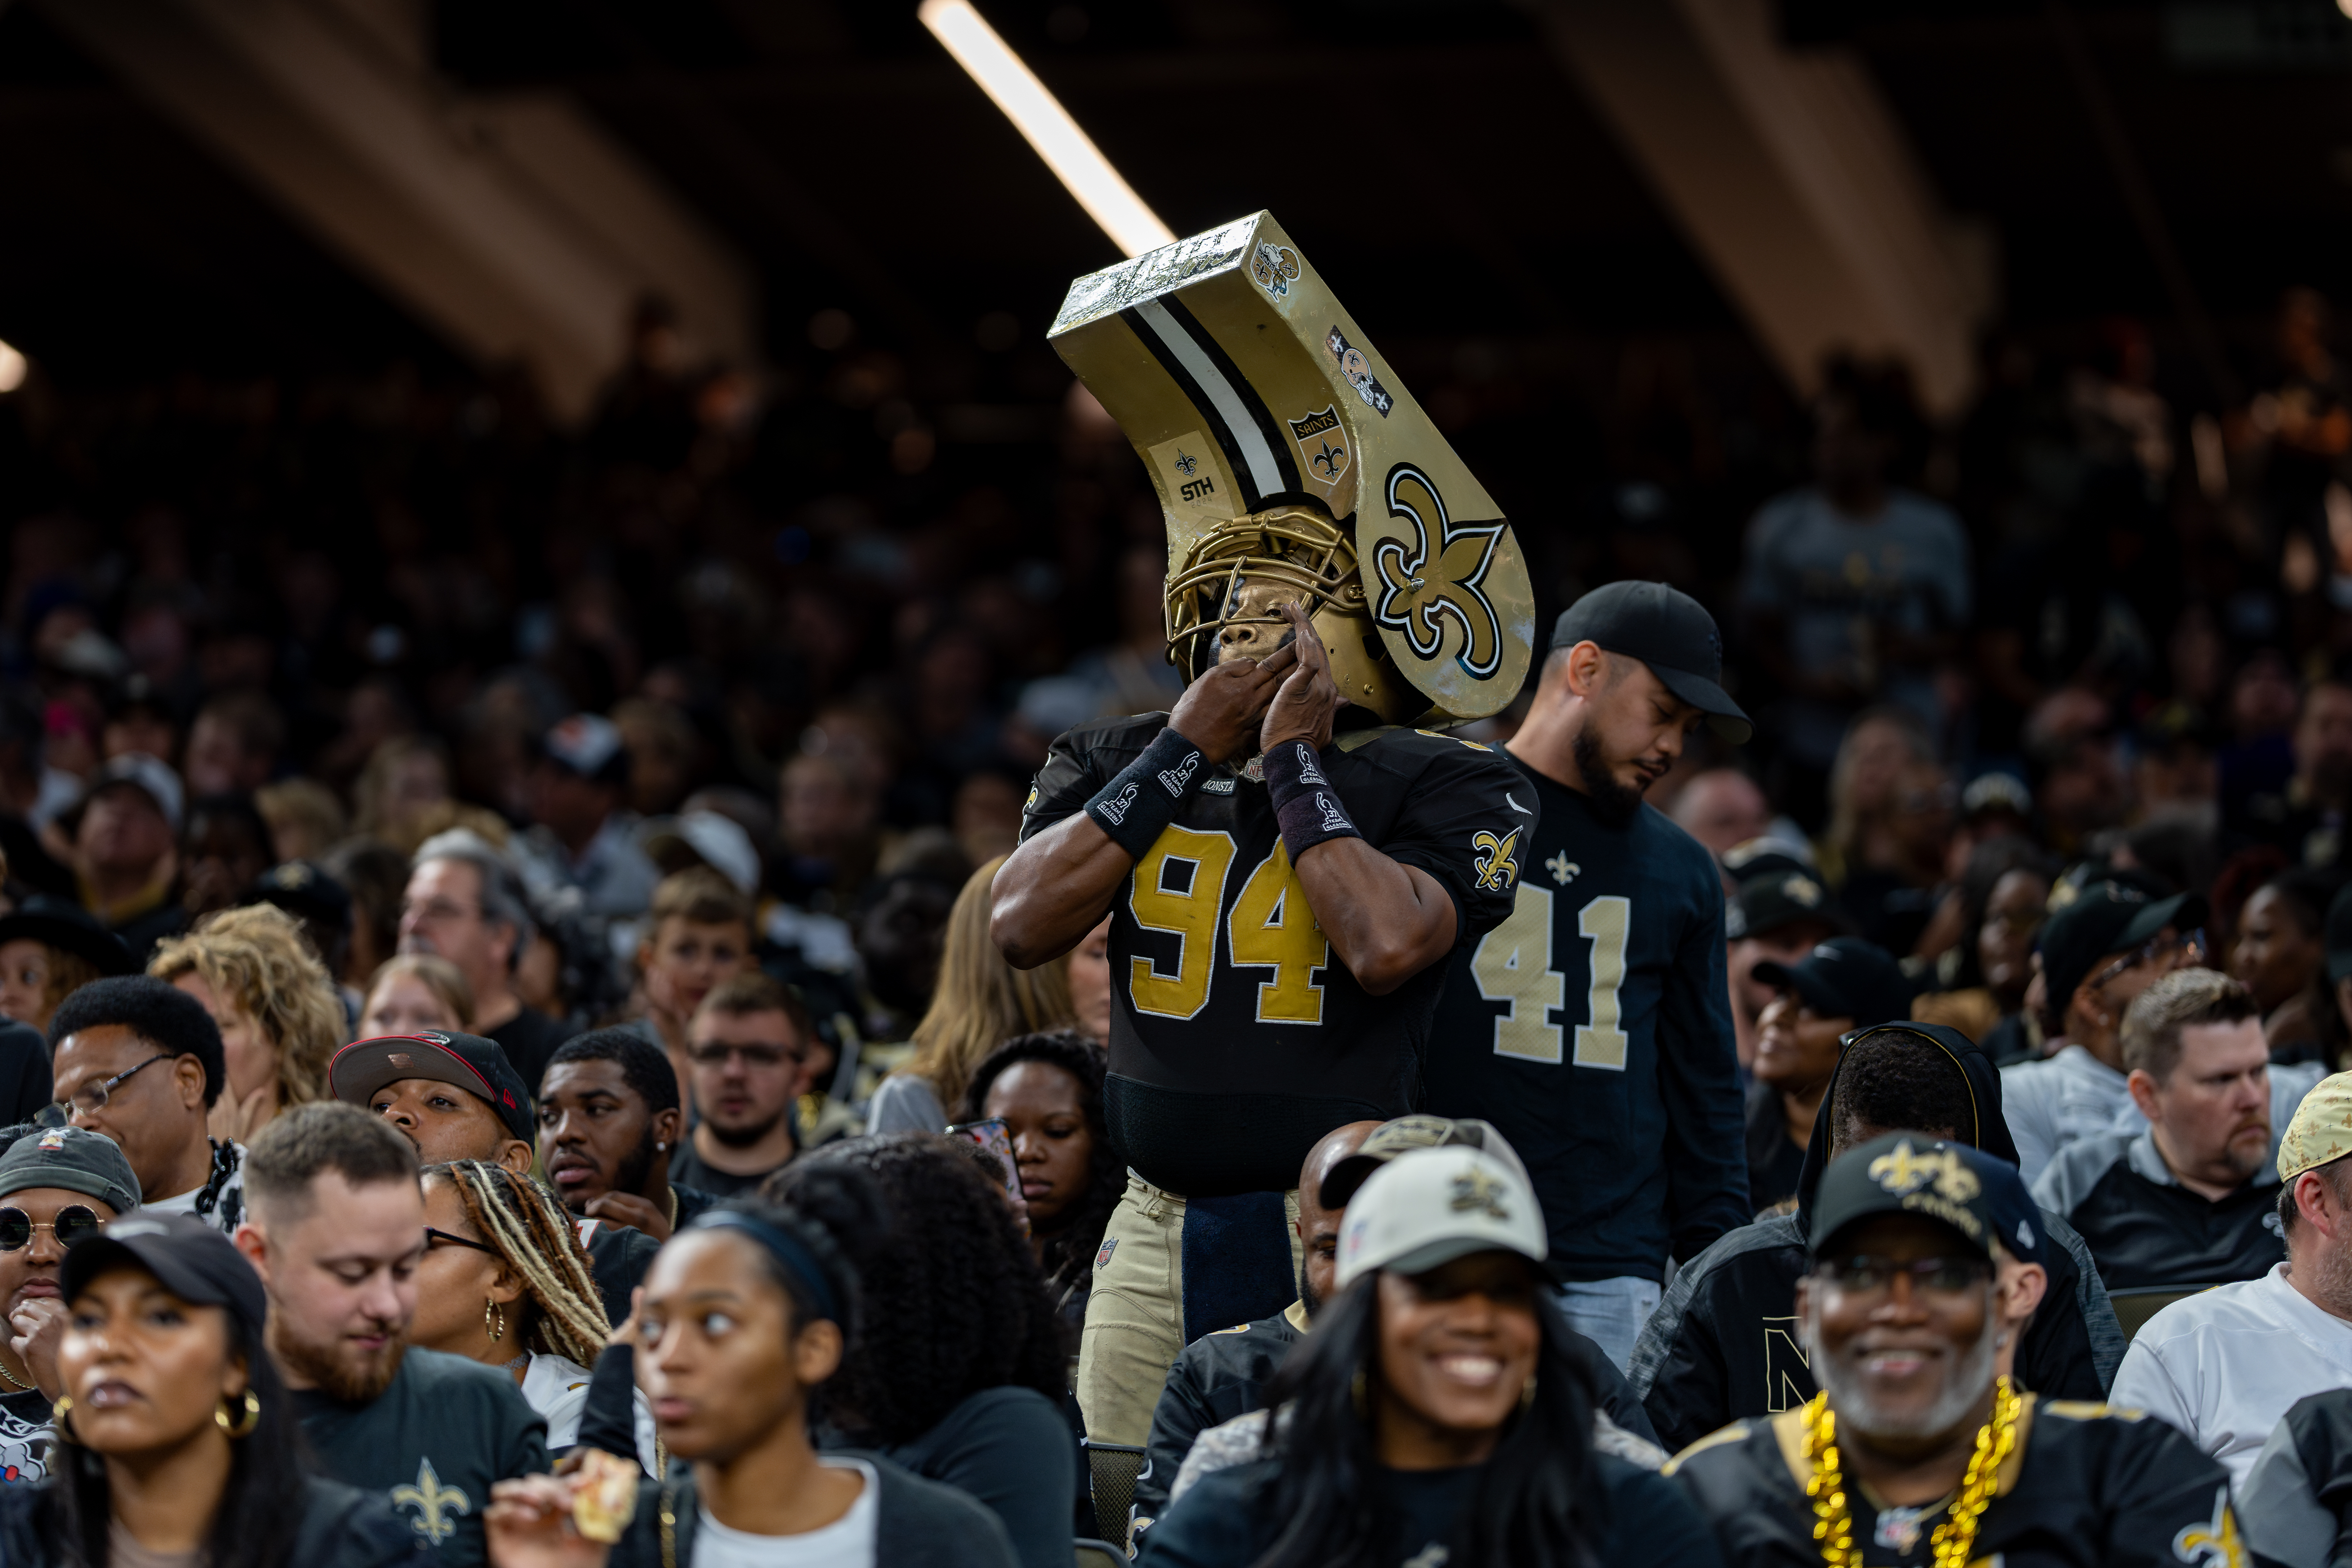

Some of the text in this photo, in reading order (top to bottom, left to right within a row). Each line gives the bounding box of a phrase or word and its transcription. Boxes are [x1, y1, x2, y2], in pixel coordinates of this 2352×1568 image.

[1257, 251, 1274, 270] SAINTS
[1298, 415, 1334, 436] SAINTS
[1180, 476, 1215, 502] STH
[1191, 496, 1212, 508] 2024
[1177, 769, 1188, 780] 37
[1248, 766, 1263, 777] NF
[1161, 775, 1179, 795] GLEASON
[1170, 774, 1180, 786] TEAM
[1110, 803, 1121, 815] TEAM
[1117, 798, 1127, 808] 37
[1101, 804, 1119, 822] GLEASON
[1129, 823, 1329, 1025] 94
[1470, 880, 1631, 1072] 41
[1098, 1250, 1110, 1263] NFL
